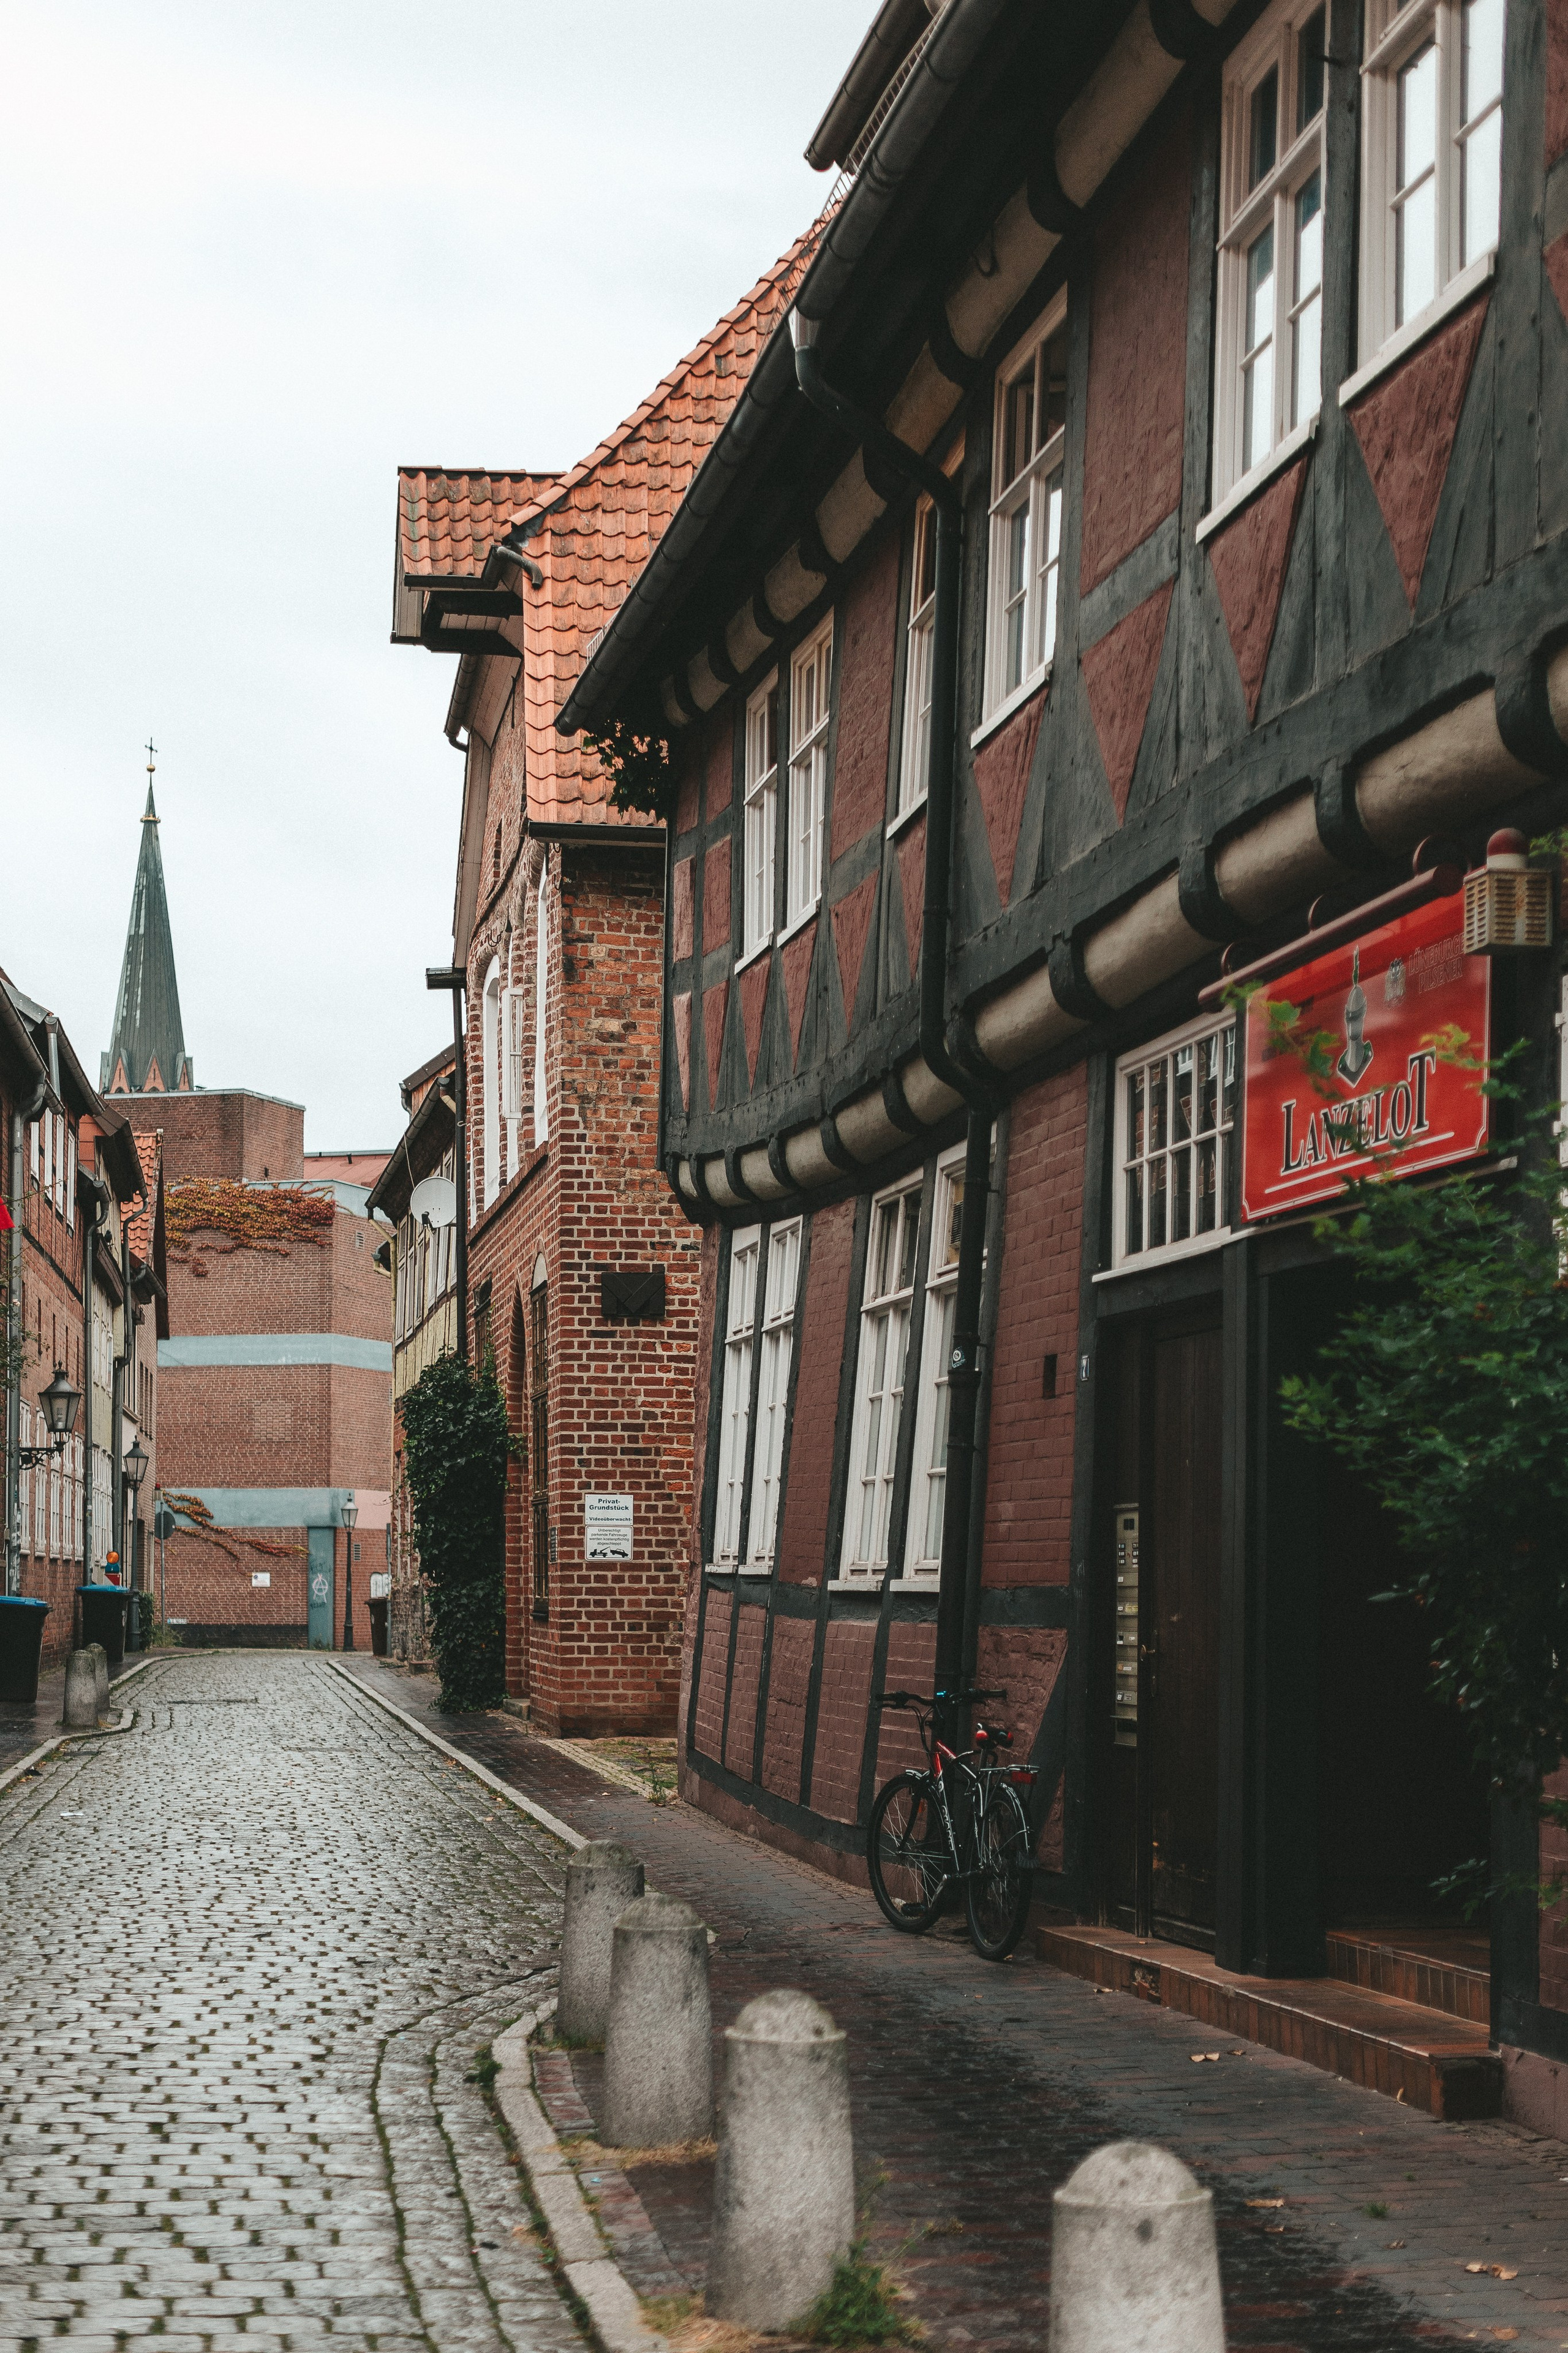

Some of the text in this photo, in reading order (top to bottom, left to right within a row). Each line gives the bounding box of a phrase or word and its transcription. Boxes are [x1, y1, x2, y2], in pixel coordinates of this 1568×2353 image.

[1409, 933, 1464, 975] LÜNEBURGE
[1419, 957, 1463, 994] PILSENER
[1281, 1046, 1436, 1176] LANZELOT
